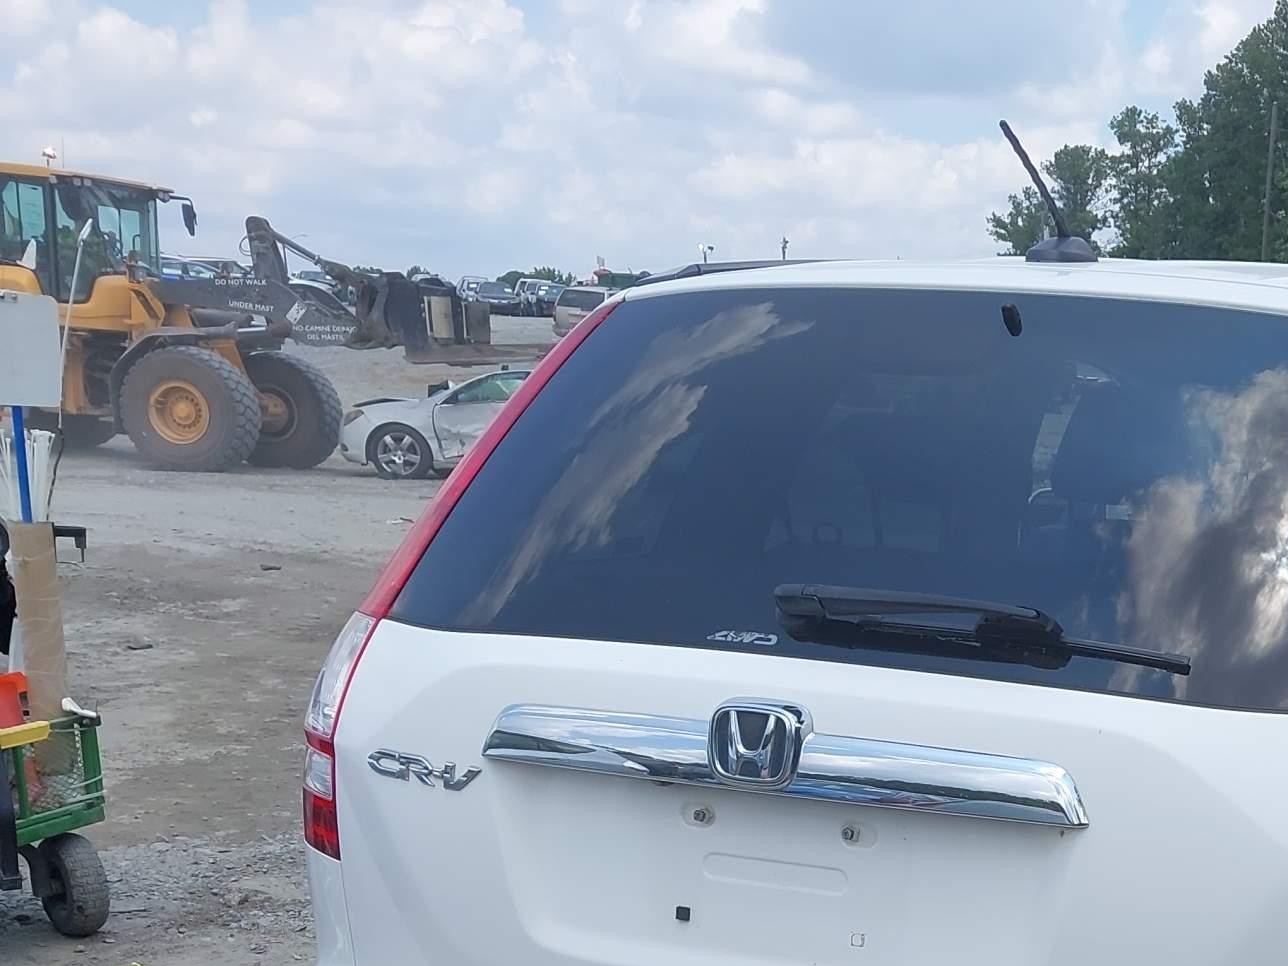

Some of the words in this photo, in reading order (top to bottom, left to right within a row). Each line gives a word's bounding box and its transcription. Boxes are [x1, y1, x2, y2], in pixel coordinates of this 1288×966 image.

[215, 278, 226, 286] DO
[228, 278, 244, 286] NOT
[246, 278, 266, 286] WALK
[228, 299, 253, 310] UNDER
[254, 303, 275, 312] MAST
[307, 333, 320, 341] DEL
